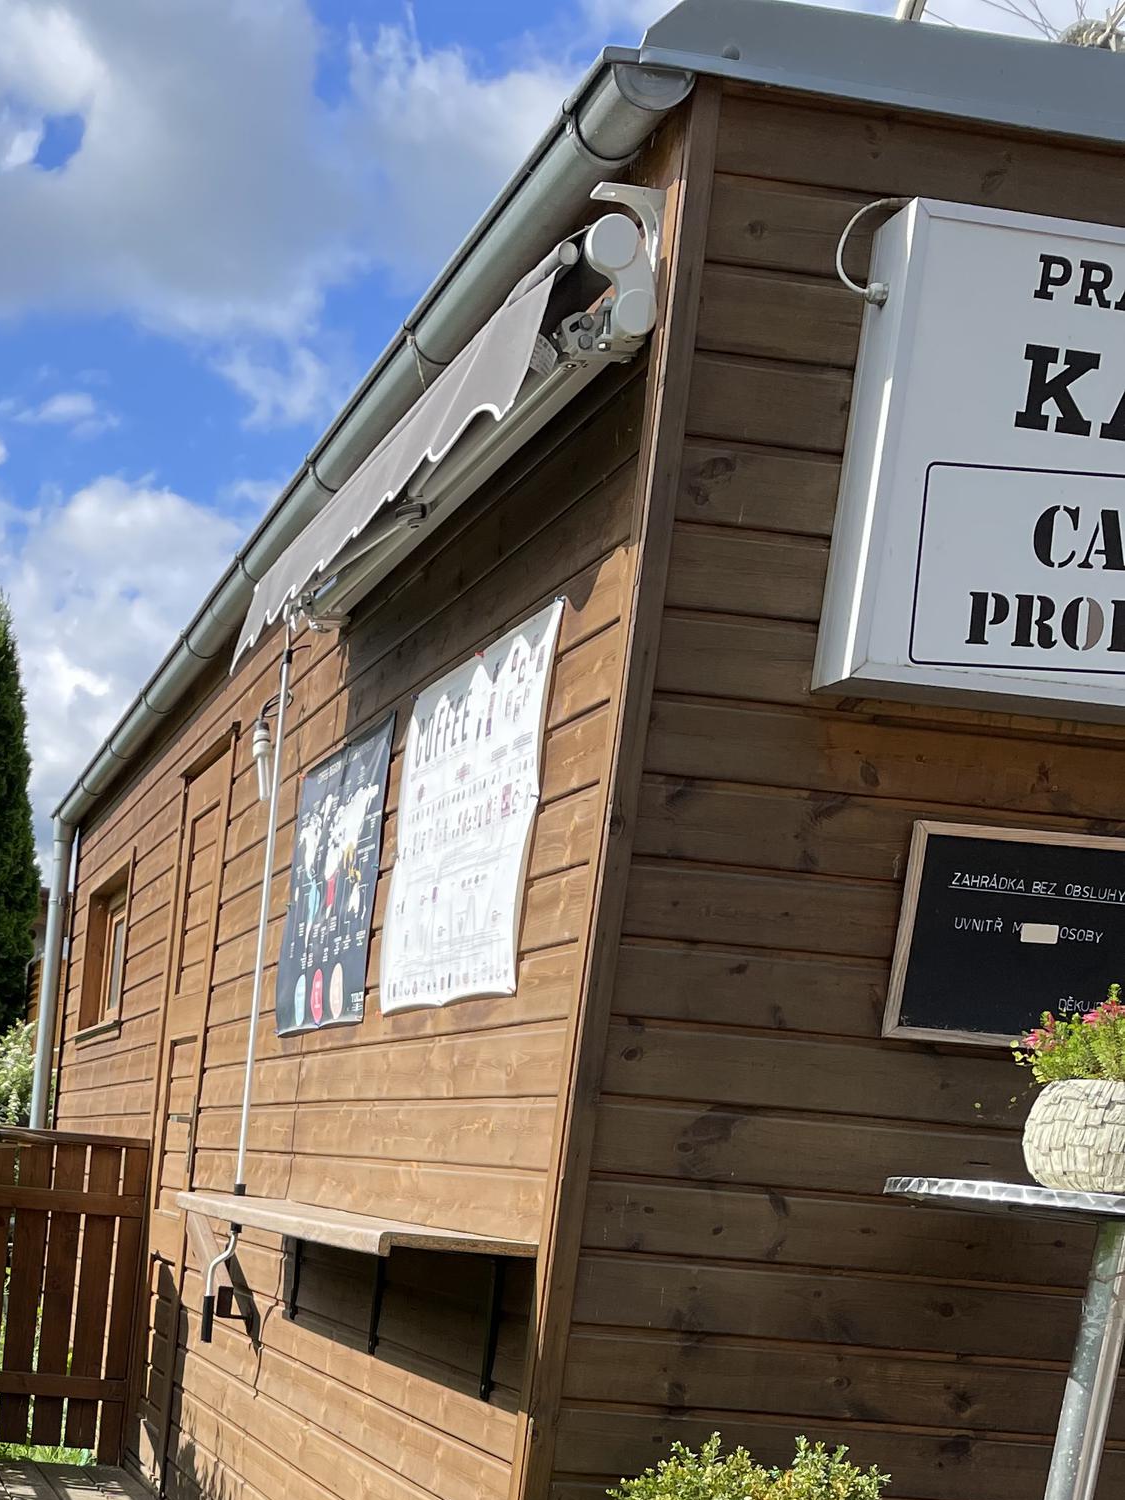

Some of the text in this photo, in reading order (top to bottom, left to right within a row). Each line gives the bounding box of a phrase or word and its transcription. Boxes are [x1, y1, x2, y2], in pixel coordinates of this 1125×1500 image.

[1033, 253, 1125, 312] PR
[415, 687, 473, 769] COFFEE
[951, 872, 1125, 901] ZAHRÁDKA BEZ OBSLUHY
[954, 916, 1004, 933] UVNITŘ
[1059, 926, 1104, 944] OSOBY
